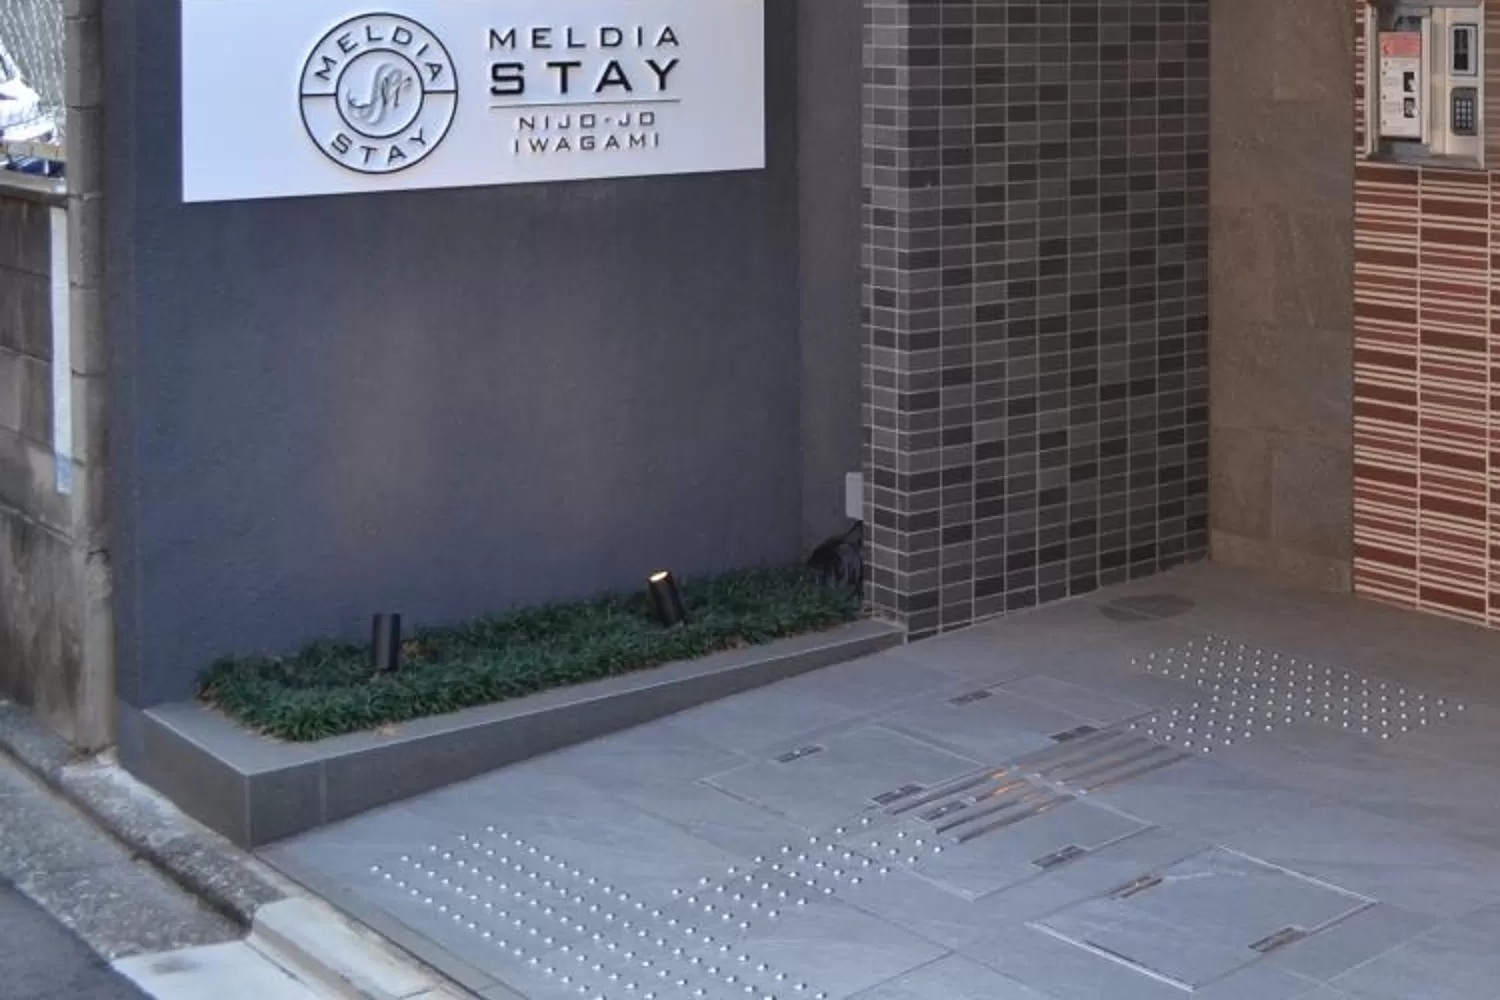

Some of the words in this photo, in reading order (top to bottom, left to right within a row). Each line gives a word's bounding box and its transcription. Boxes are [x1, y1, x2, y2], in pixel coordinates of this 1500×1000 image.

[314, 25, 444, 83] MELDIA
[489, 25, 680, 51] MELDIA
[490, 58, 680, 97] STAY
[518, 111, 656, 131] NIJO-JO
[330, 127, 430, 165] STAY
[514, 132, 661, 155] IWAGAMI
